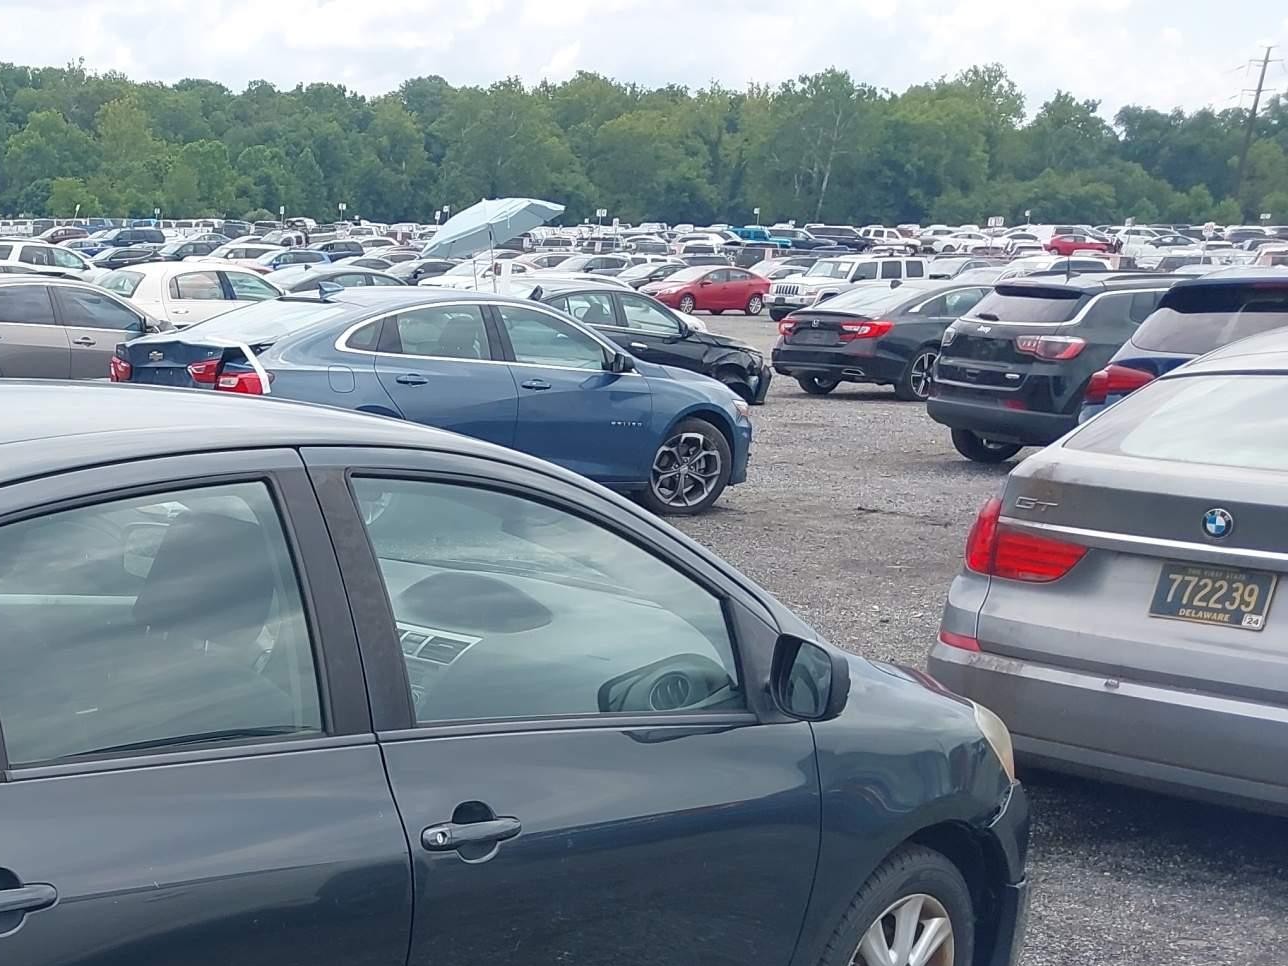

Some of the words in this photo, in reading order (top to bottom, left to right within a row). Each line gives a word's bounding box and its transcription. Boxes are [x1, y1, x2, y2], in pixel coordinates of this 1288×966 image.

[1015, 496, 1059, 511] GT
[1166, 573, 1259, 612] 772239
[1178, 607, 1231, 622] DELAWARE
[1247, 617, 1259, 626] 24
